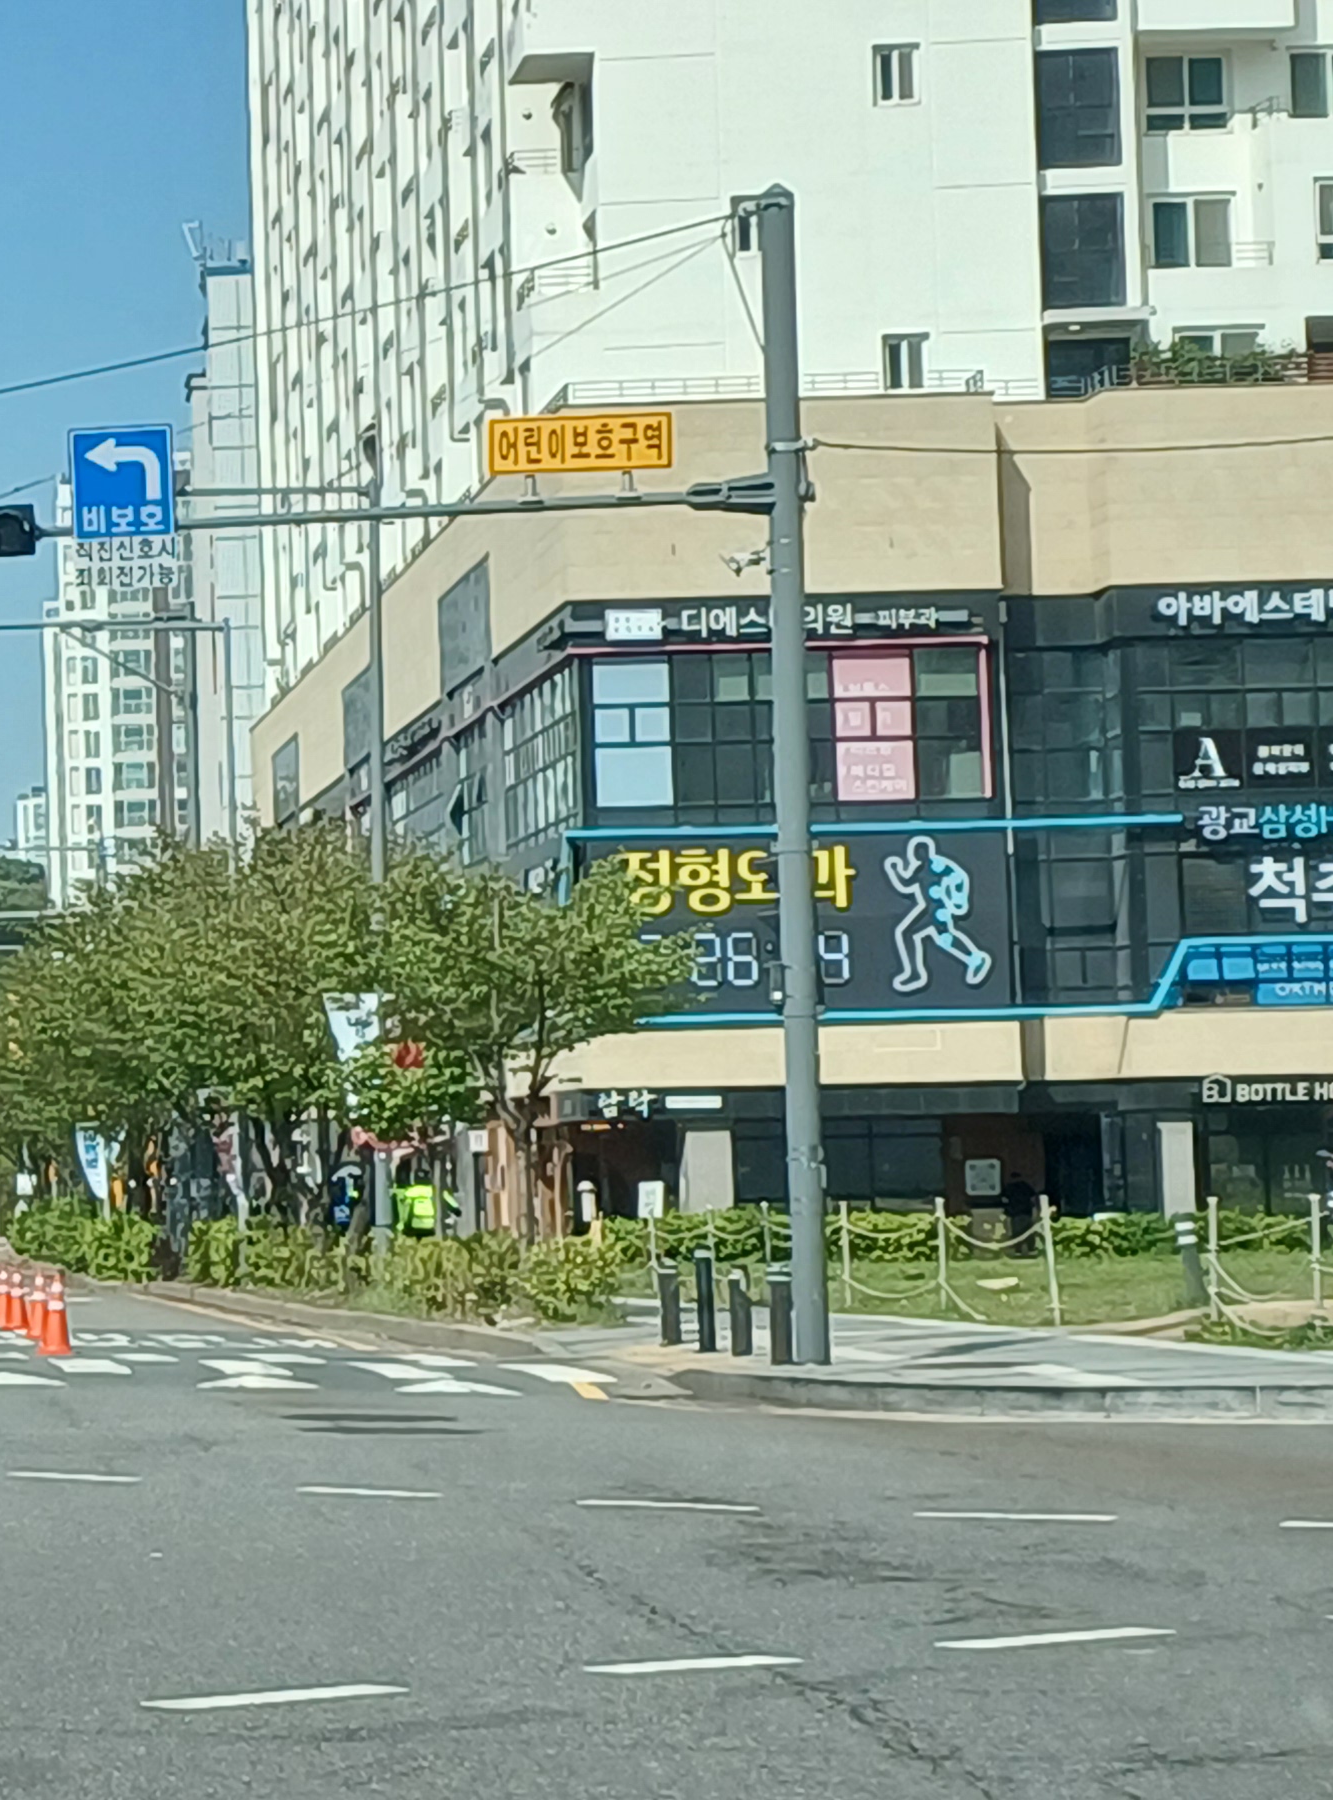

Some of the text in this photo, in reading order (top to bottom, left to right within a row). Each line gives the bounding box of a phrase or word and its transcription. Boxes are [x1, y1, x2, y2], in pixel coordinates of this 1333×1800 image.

[498, 420, 662, 466] 어린이보호구역
[82, 504, 165, 534] 비보호
[876, 607, 939, 630] 피부과
[1157, 588, 1333, 626] 아바에스테
[1236, 1082, 1310, 1102] BOTTLE
